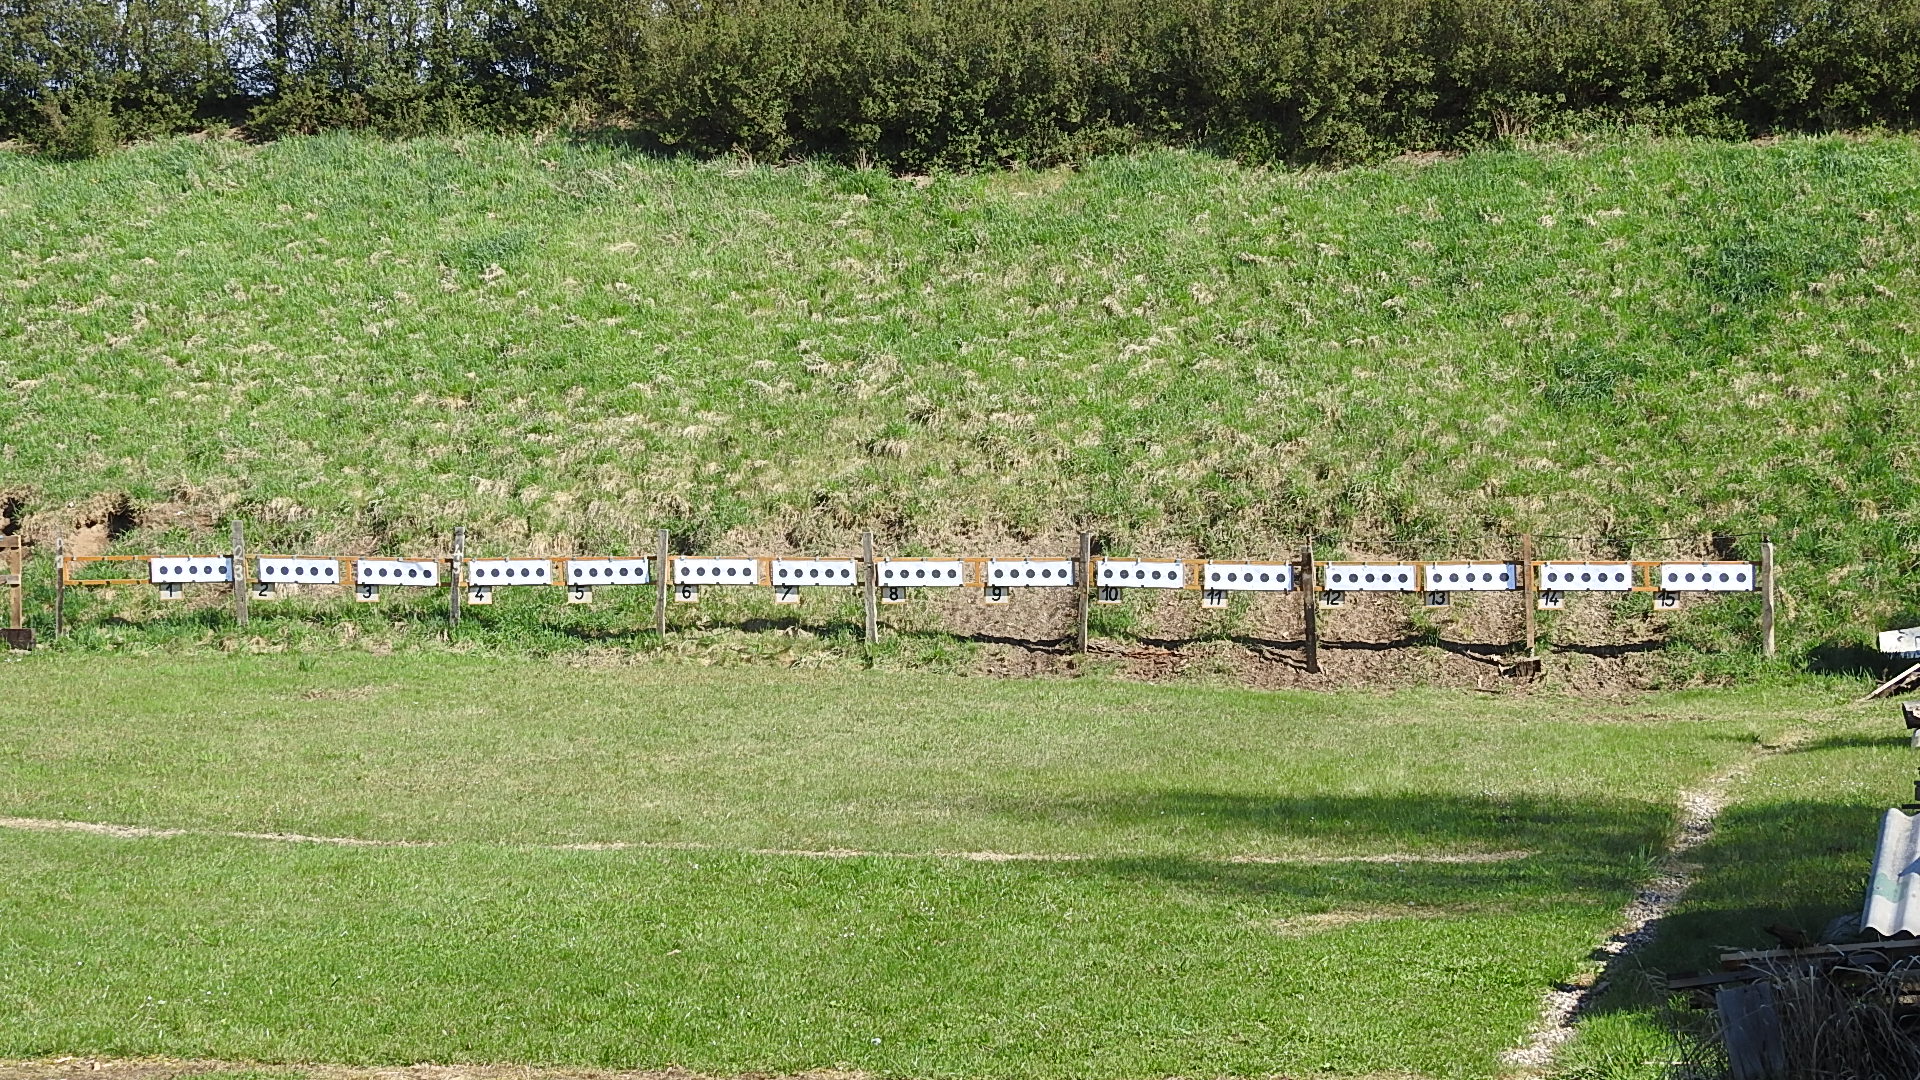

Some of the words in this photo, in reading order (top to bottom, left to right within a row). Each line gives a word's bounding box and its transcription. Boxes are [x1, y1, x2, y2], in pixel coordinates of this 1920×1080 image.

[166, 583, 173, 598] 1
[258, 583, 268, 597] 2
[363, 584, 372, 599] 3
[475, 585, 484, 601] 4
[575, 585, 584, 600] 5
[682, 585, 691, 600] 6
[782, 585, 793, 601] 7
[889, 587, 898, 601] 8
[992, 586, 1002, 601] 9
[1102, 586, 1118, 602] 10
[1207, 589, 1221, 606] 11
[1323, 590, 1341, 606] 12
[1428, 591, 1446, 606] 13
[1542, 590, 1559, 606] 14
[1658, 591, 1675, 607] 15
